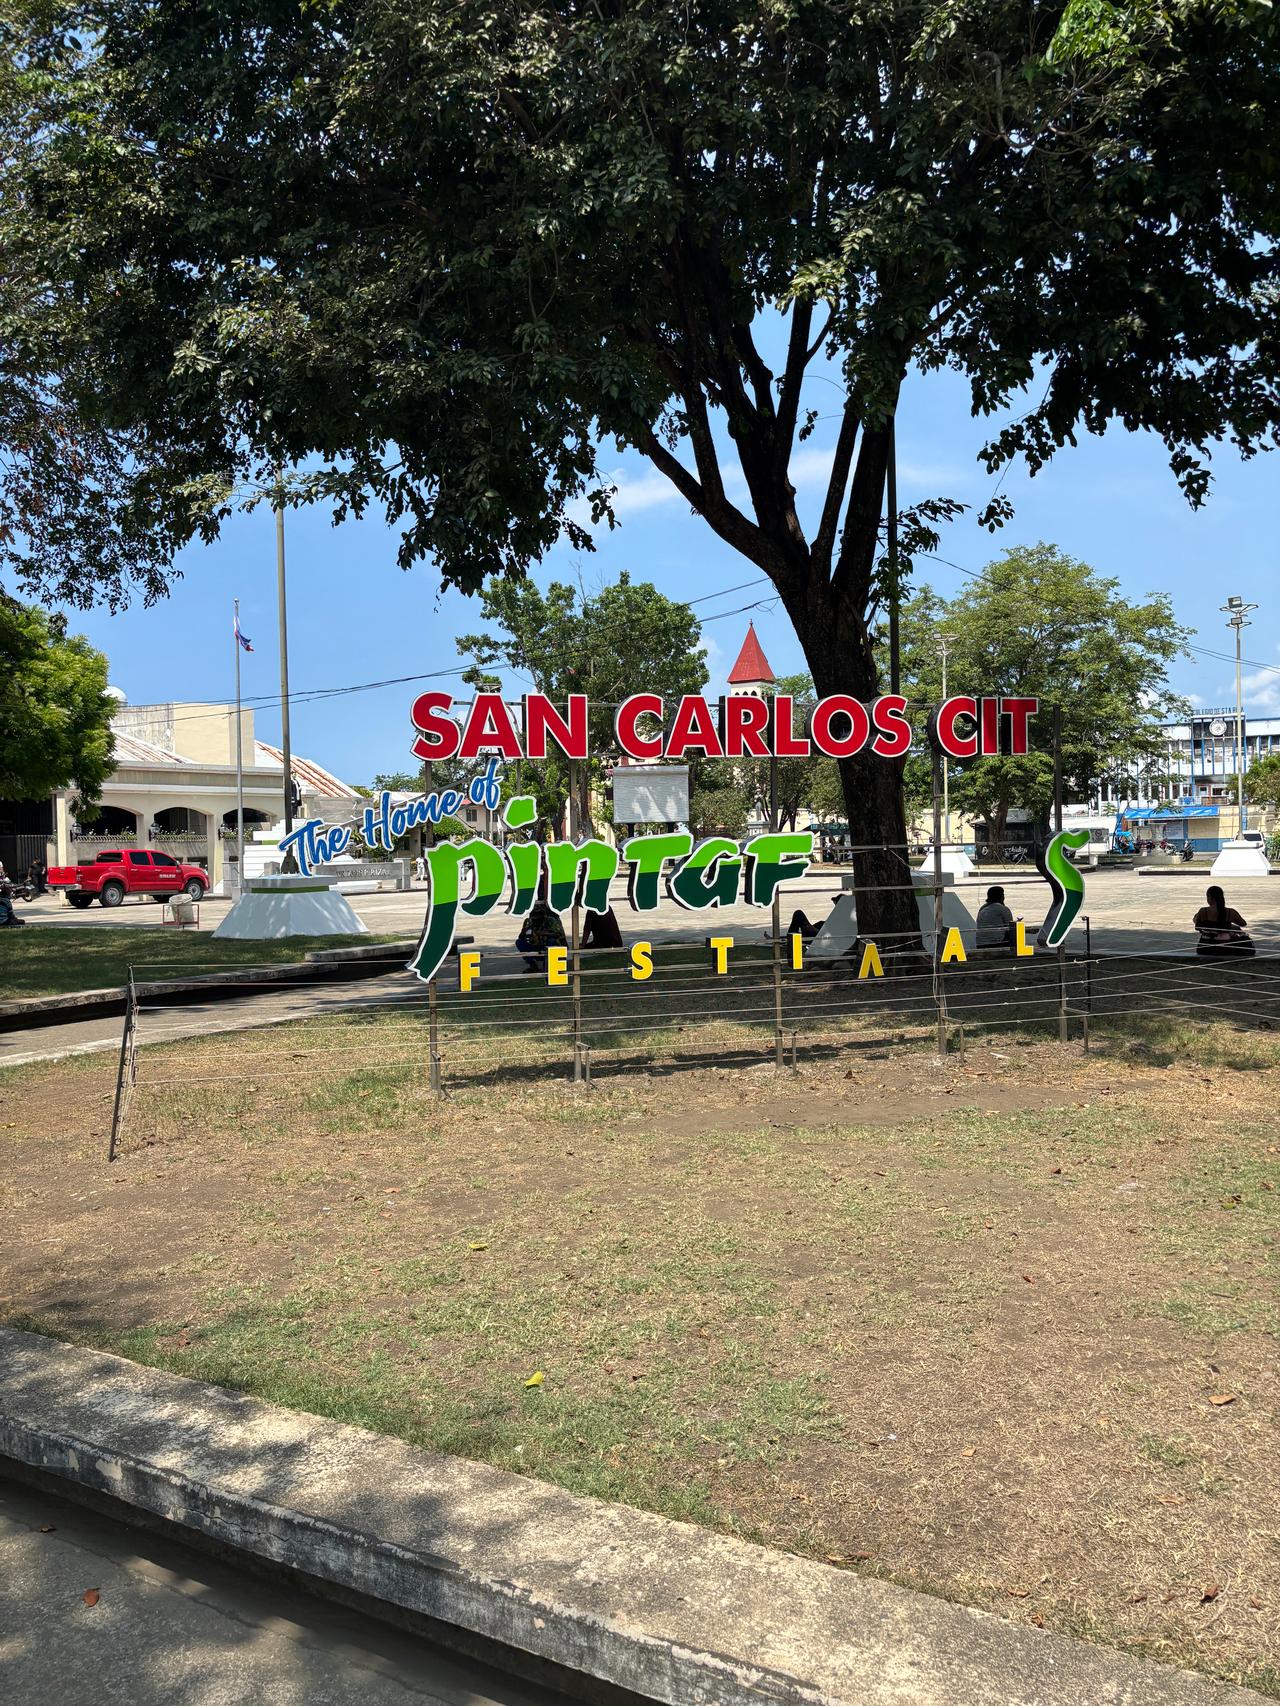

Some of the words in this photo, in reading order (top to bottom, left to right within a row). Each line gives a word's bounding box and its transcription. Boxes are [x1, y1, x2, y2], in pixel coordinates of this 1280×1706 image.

[411, 691, 589, 761] SAN
[614, 694, 913, 760] CARLOS
[934, 695, 1039, 758] CIT
[278, 816, 352, 877] The
[359, 790, 465, 851] Home
[469, 757, 504, 810] of
